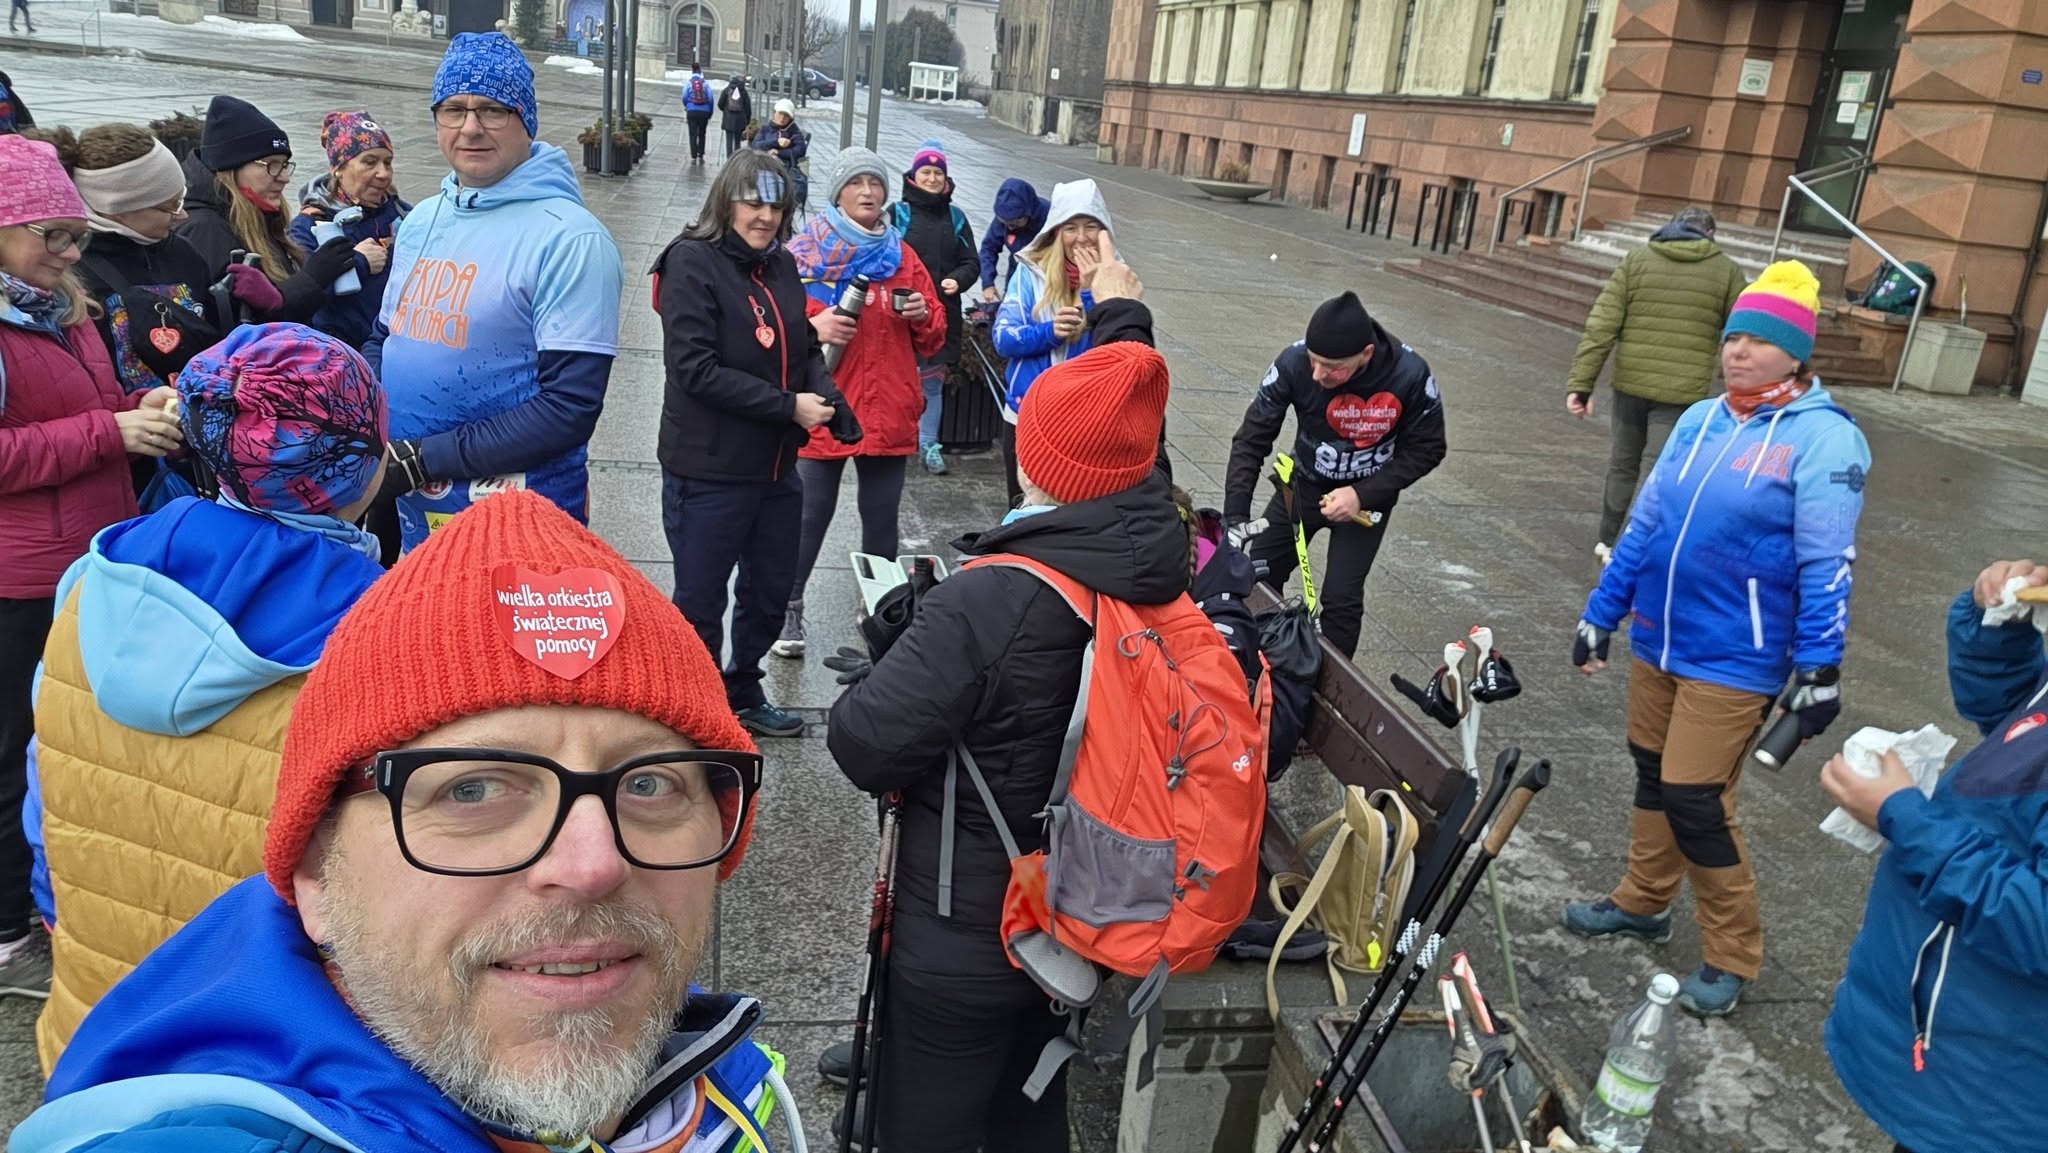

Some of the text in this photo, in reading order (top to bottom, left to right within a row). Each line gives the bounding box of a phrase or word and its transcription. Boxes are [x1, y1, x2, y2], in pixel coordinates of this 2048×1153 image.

[1332, 404, 1397, 418] wielka orkiestra
[1299, 554, 1315, 598] FIZAN
[496, 583, 613, 608] wielka orkiestra
[512, 609, 608, 640] świątecznej
[534, 637, 597, 660] pomocy
